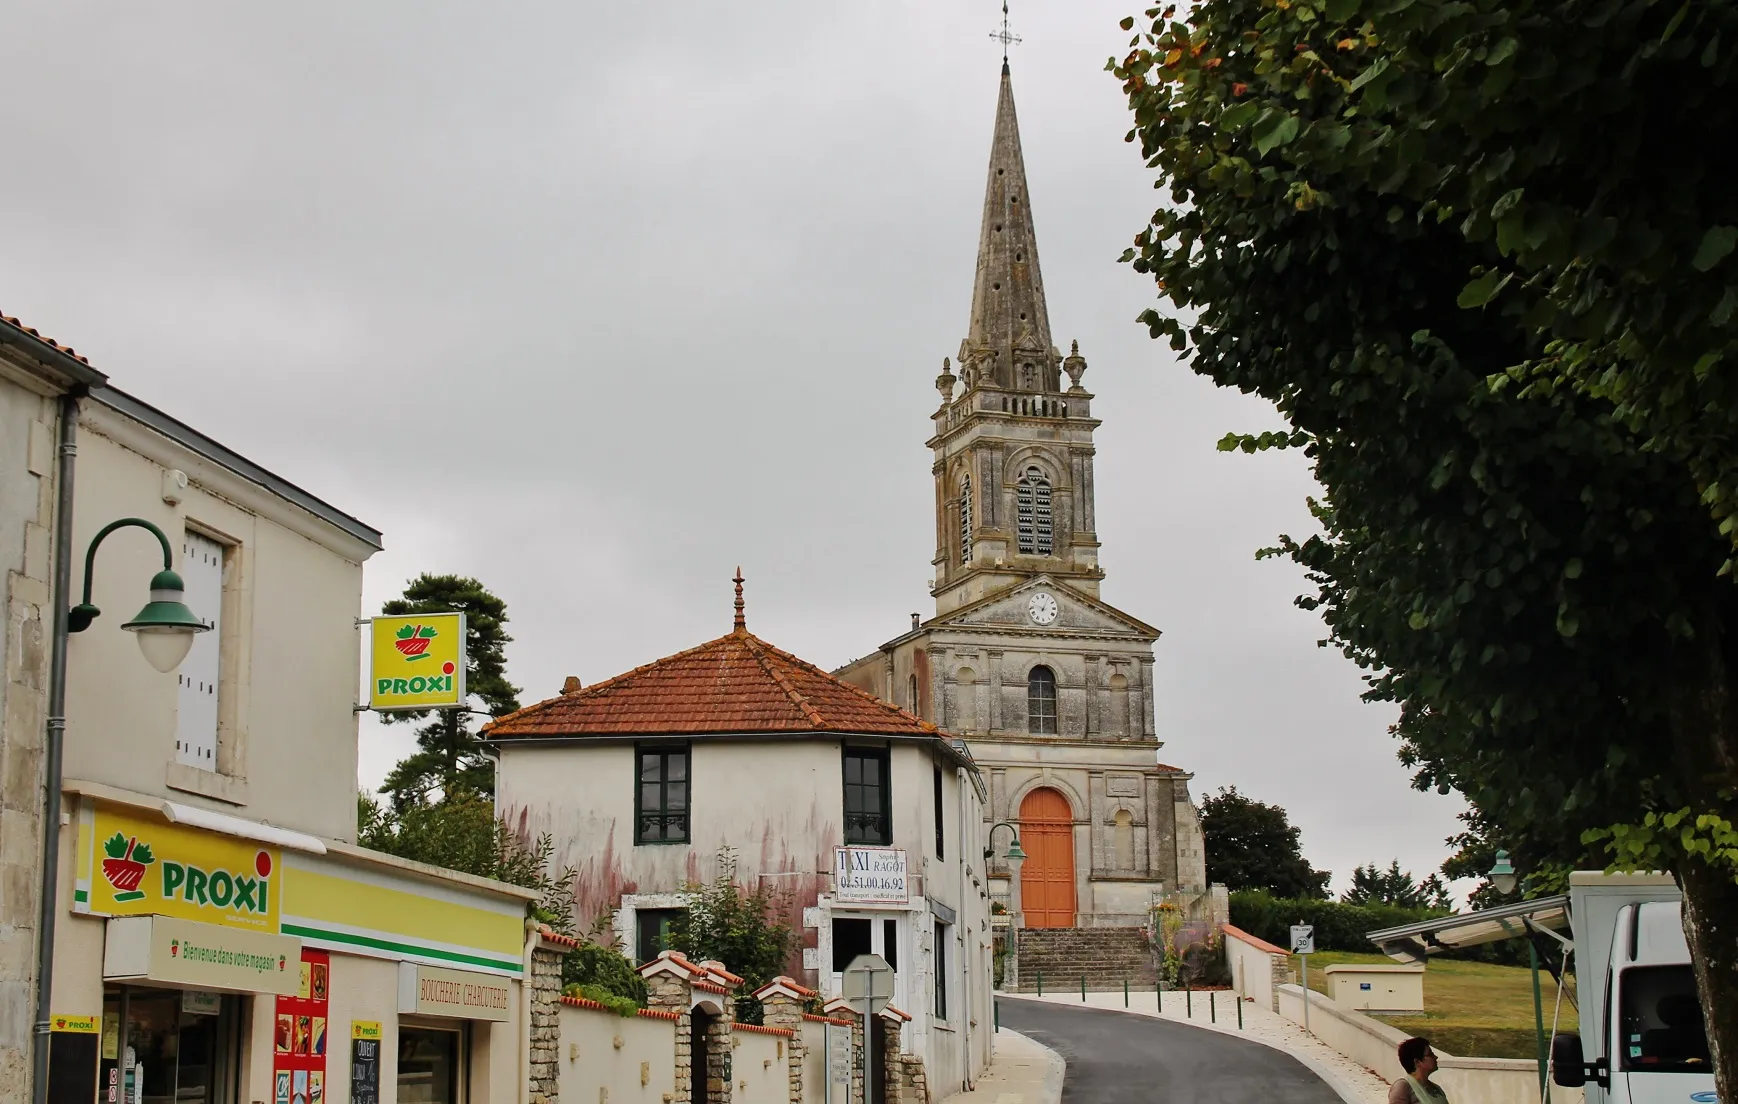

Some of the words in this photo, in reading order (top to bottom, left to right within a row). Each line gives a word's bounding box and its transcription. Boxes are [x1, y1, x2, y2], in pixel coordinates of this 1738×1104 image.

[378, 662, 454, 695] PROXI
[162, 851, 272, 913] PROXI
[873, 861, 905, 872] RAGOT
[183, 940, 217, 963] Bienvenue
[217, 945, 233, 965] dans
[234, 950, 250, 967] votre
[249, 953, 275, 974] magasin
[420, 978, 461, 1004] BOUCHERIE
[463, 983, 507, 1009] CHARCUTERIE
